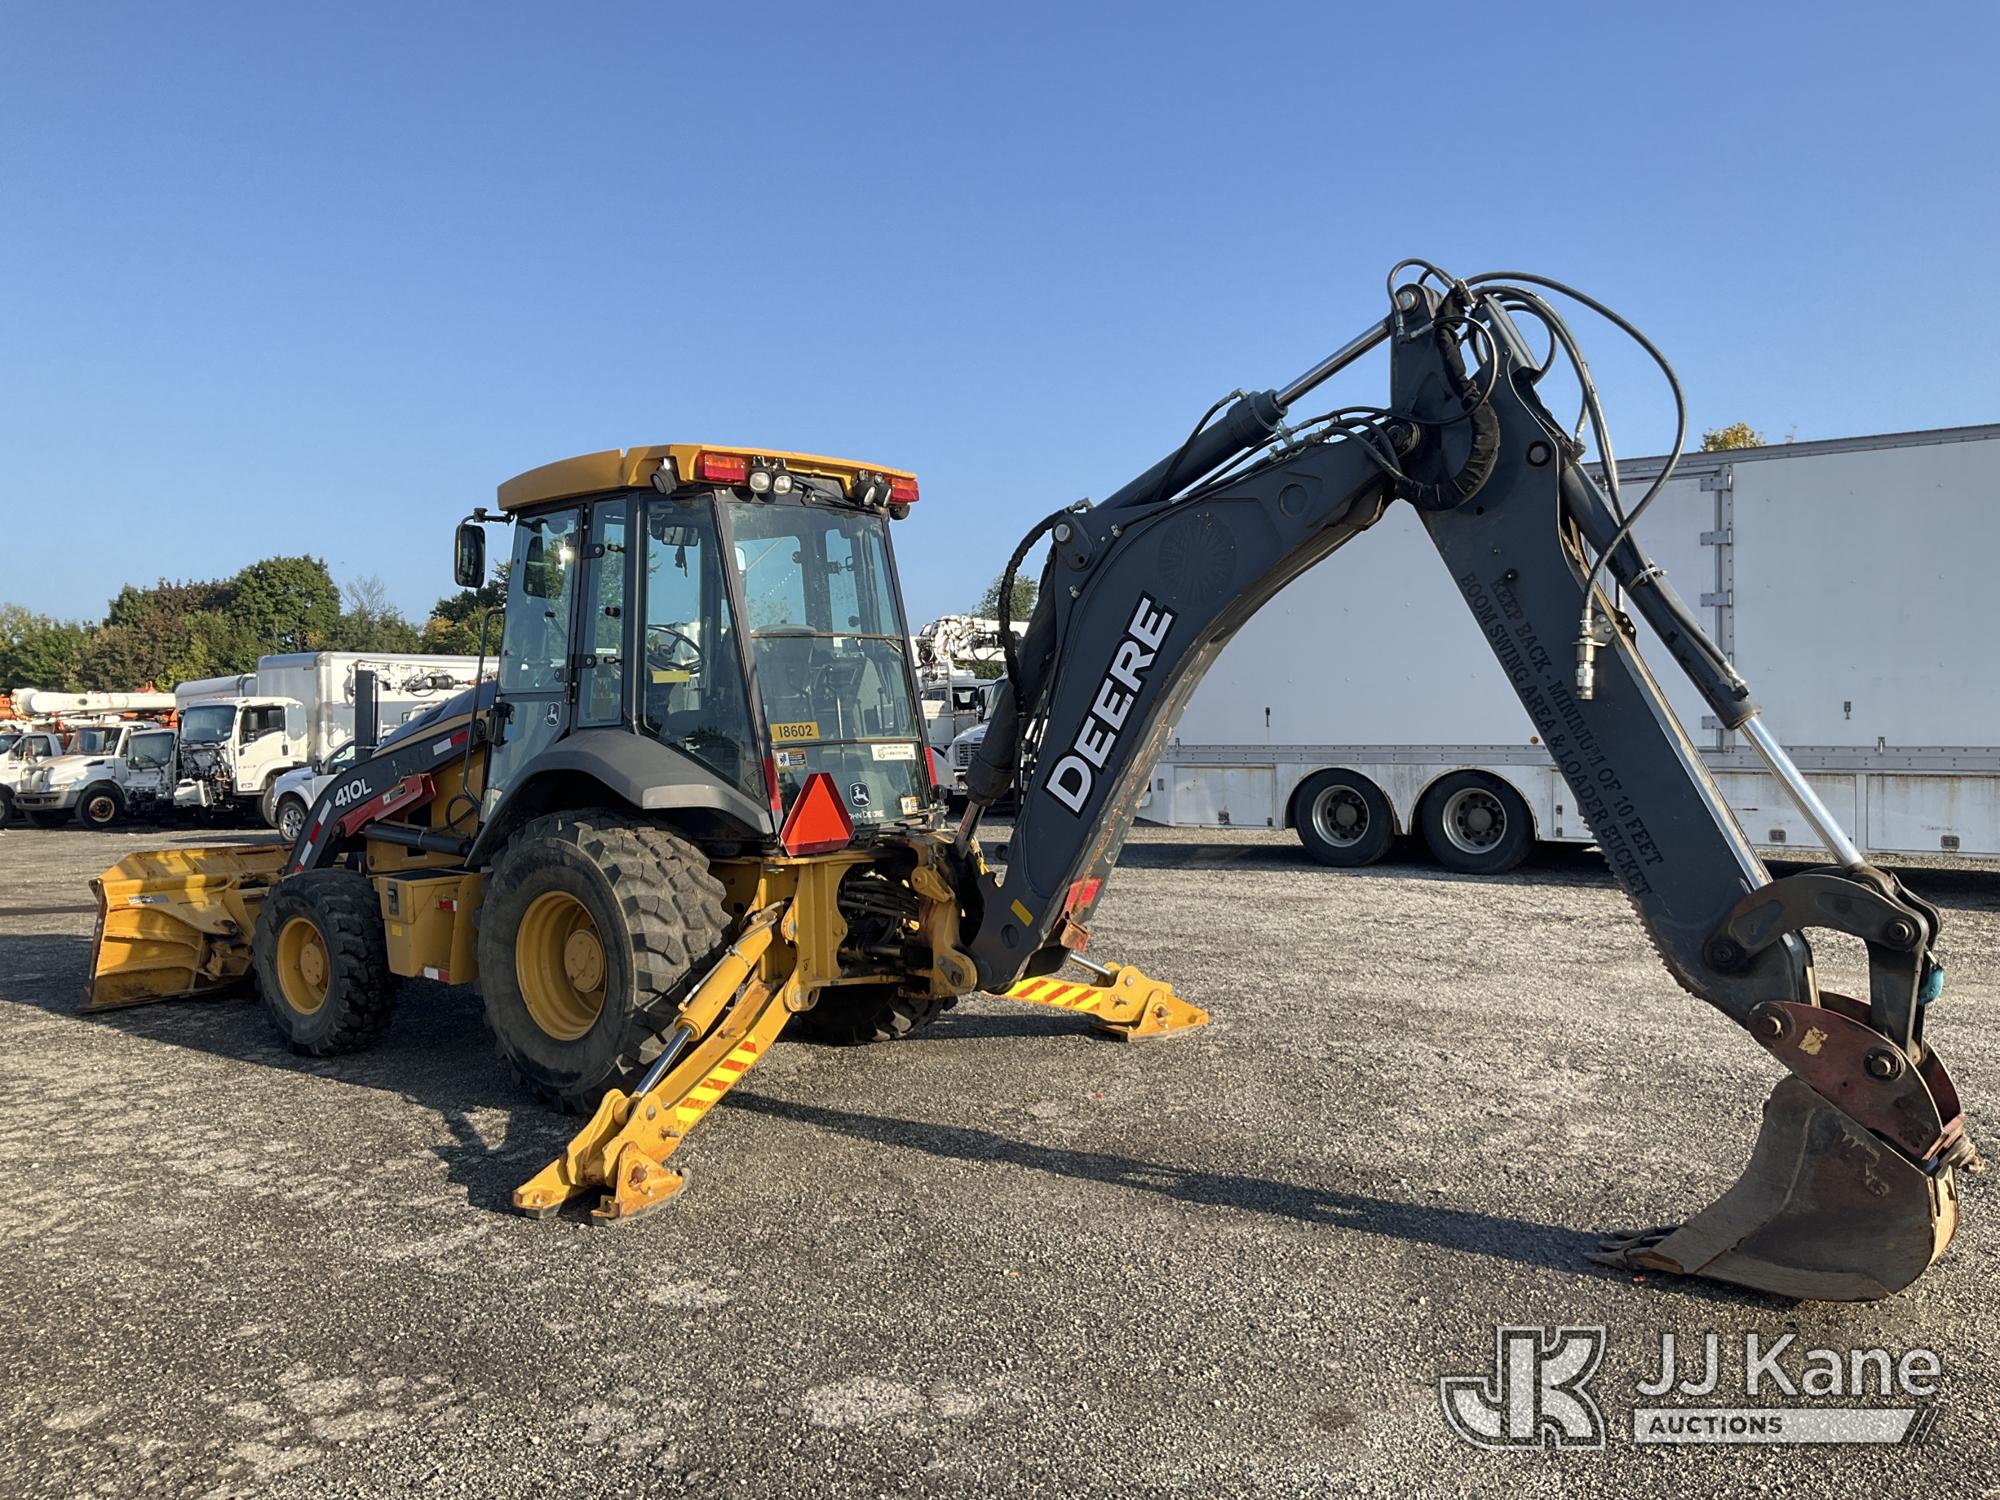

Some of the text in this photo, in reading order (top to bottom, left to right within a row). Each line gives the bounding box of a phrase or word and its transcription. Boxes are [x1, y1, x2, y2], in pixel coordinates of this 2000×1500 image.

[335, 778, 372, 807] 410L
[778, 725, 813, 738] 18602
[1046, 597, 1173, 813] DEERE
[1460, 572, 1653, 897] BOOM SWING AREA & LOADER BUCKET
[1489, 576, 1523, 620] KEEP
[1515, 622, 1552, 673] BACK
[1547, 680, 1608, 767] MINIMUM
[1597, 767, 1622, 791] OF
[1614, 795, 1634, 817] 10
[1625, 816, 1664, 866] FEET
